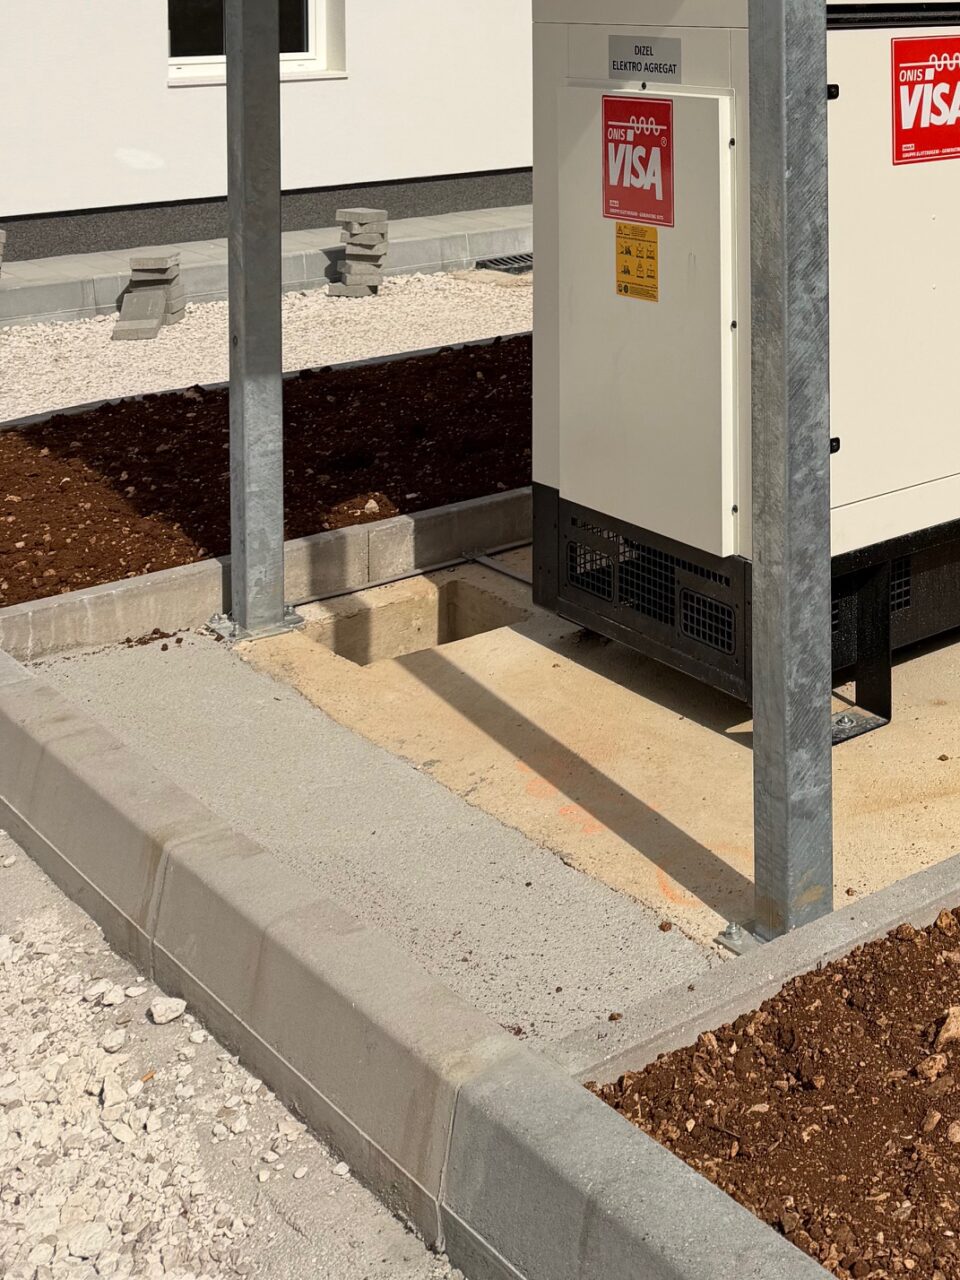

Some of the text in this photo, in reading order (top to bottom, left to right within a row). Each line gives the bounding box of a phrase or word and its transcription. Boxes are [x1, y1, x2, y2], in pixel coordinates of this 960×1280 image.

[634, 45, 654, 56] DIZEL
[612, 60, 677, 74] ELEKTRO AGREGAT
[899, 69, 923, 82] ONIS
[608, 128, 626, 140] ONIS
[608, 129, 663, 200] VISA
